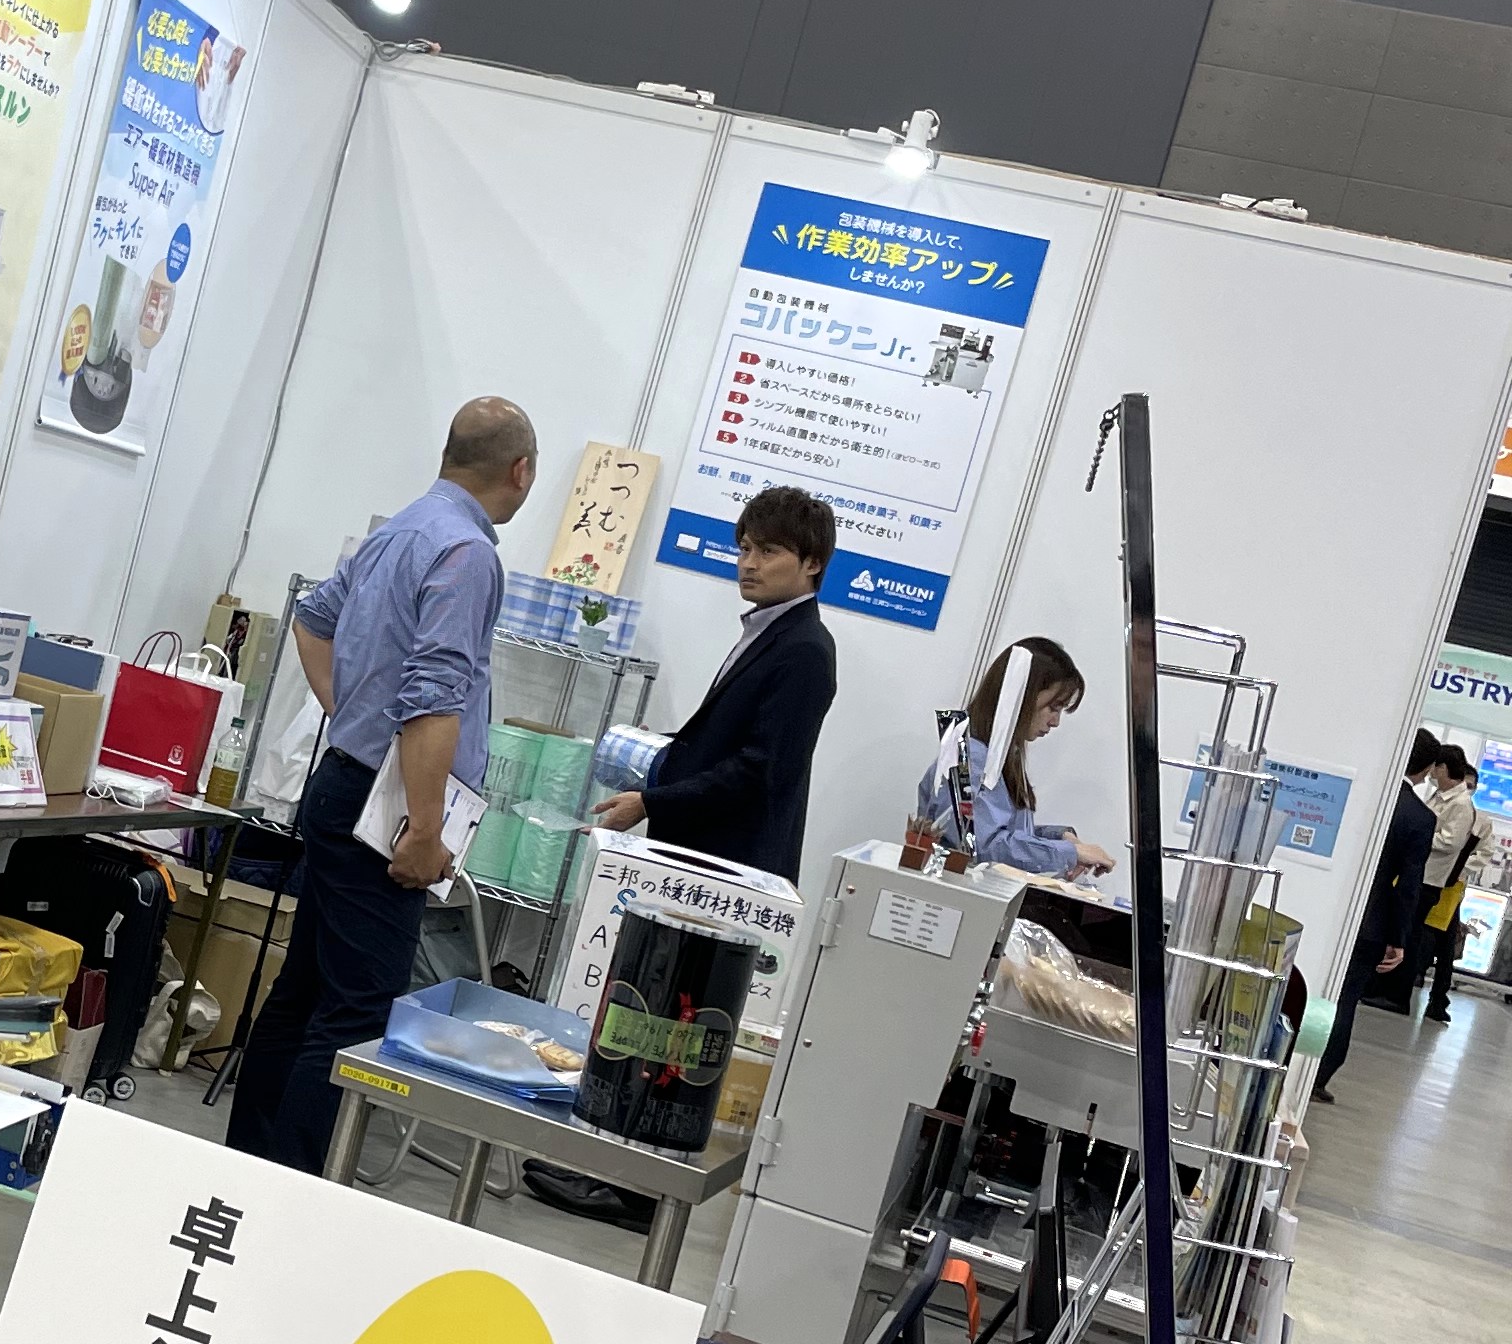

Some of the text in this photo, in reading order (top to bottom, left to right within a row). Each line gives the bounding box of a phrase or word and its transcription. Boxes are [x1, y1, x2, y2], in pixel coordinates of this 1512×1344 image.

[128, 162, 159, 199] Super
[795, 222, 998, 288] 作業効率アップ
[848, 266, 926, 296] しませんか?
[876, 577, 936, 602] MIKUNI
[597, 862, 796, 939] 三邦の緩衝材製造機
[588, 923, 607, 949] A
[583, 962, 604, 989] B
[575, 1002, 592, 1021] C
